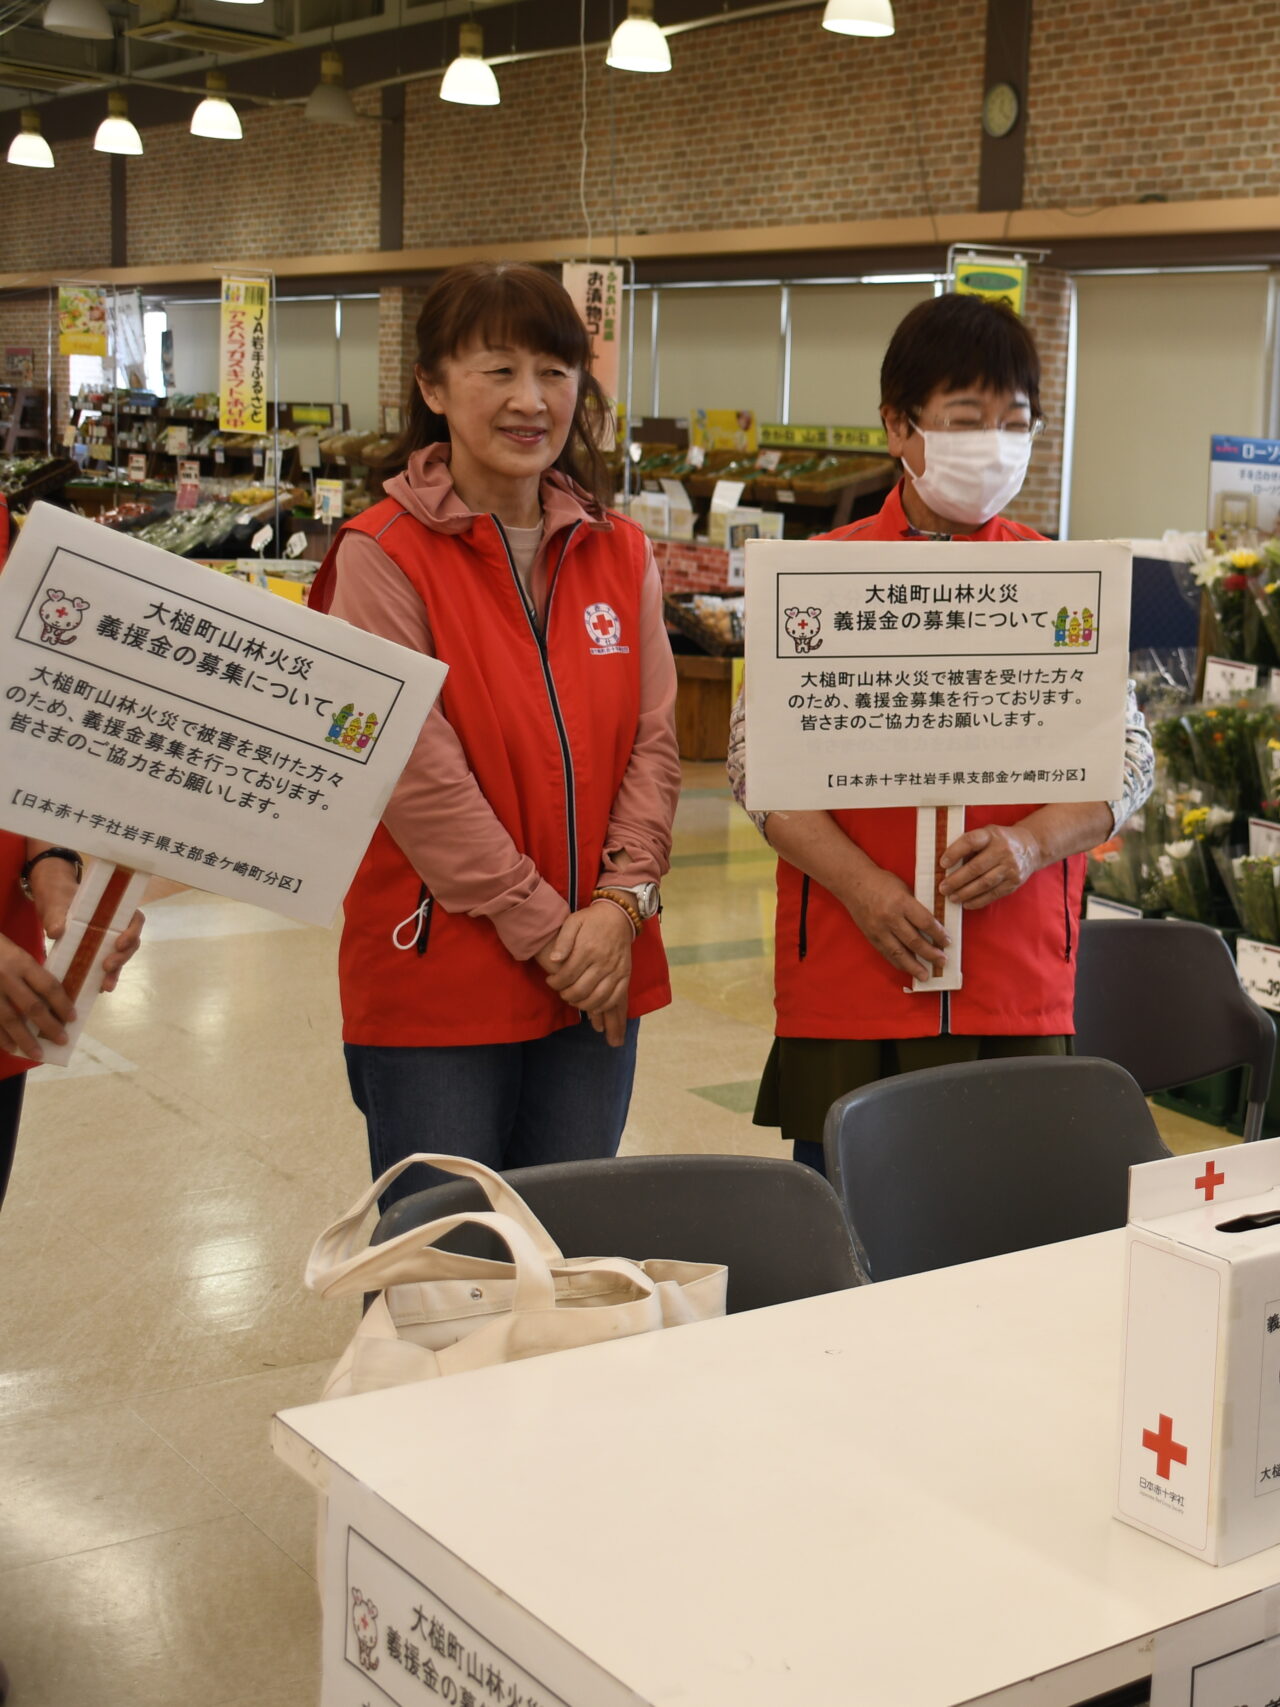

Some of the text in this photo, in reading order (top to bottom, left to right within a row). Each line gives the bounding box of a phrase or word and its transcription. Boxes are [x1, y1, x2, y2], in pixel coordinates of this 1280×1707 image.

[251, 308, 264, 424] JA岩手ふるさと
[833, 610, 1049, 632] 義援金の募集について
[865, 584, 1019, 604] 大槌町山林火災
[96, 615, 334, 718] 義援金の募集について
[144, 602, 315, 681] 大槌町山林火災
[788, 690, 1083, 709] のため、義援金募集を行っております。
[801, 668, 1085, 688] 大槌町山林火災で被害を受けた方々
[6, 685, 330, 812] のため、義援金募集を行っております。
[30, 666, 344, 788] 大槌町山林火災で被害を受けた方々
[801, 711, 1045, 732] 皆さまのご協力をお願いします。
[9, 711, 282, 820] 皆さまのご協力をお願いします。
[1139, 1476, 1185, 1508] 日本赤十字社
